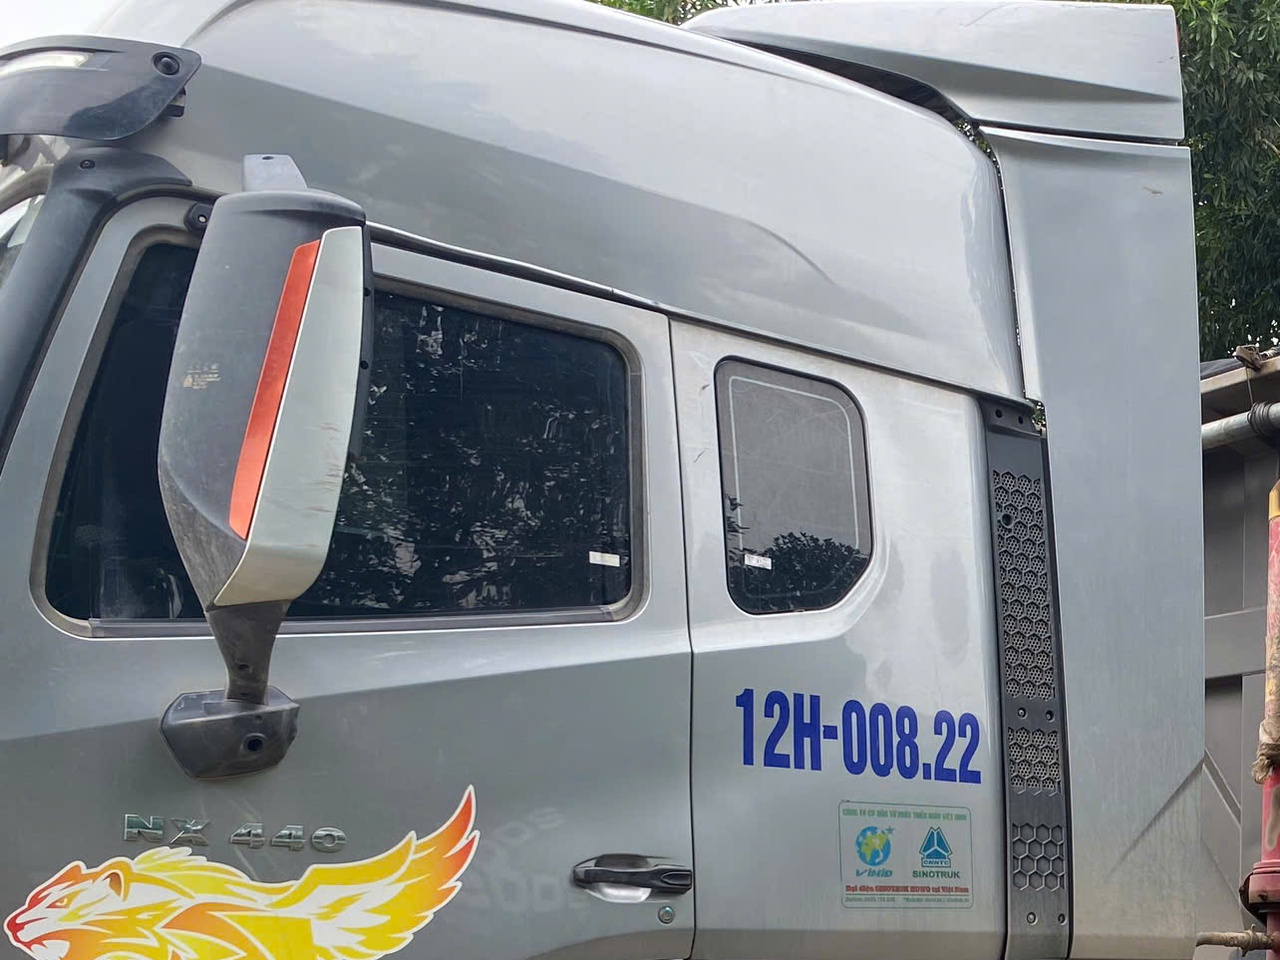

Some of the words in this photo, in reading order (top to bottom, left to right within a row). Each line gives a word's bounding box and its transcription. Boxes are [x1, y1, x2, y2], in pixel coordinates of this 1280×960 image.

[735, 688, 982, 785] 12H-008.22
[123, 813, 212, 846] NX
[229, 822, 348, 853] 440
[912, 870, 960, 879] SINOTRUK
